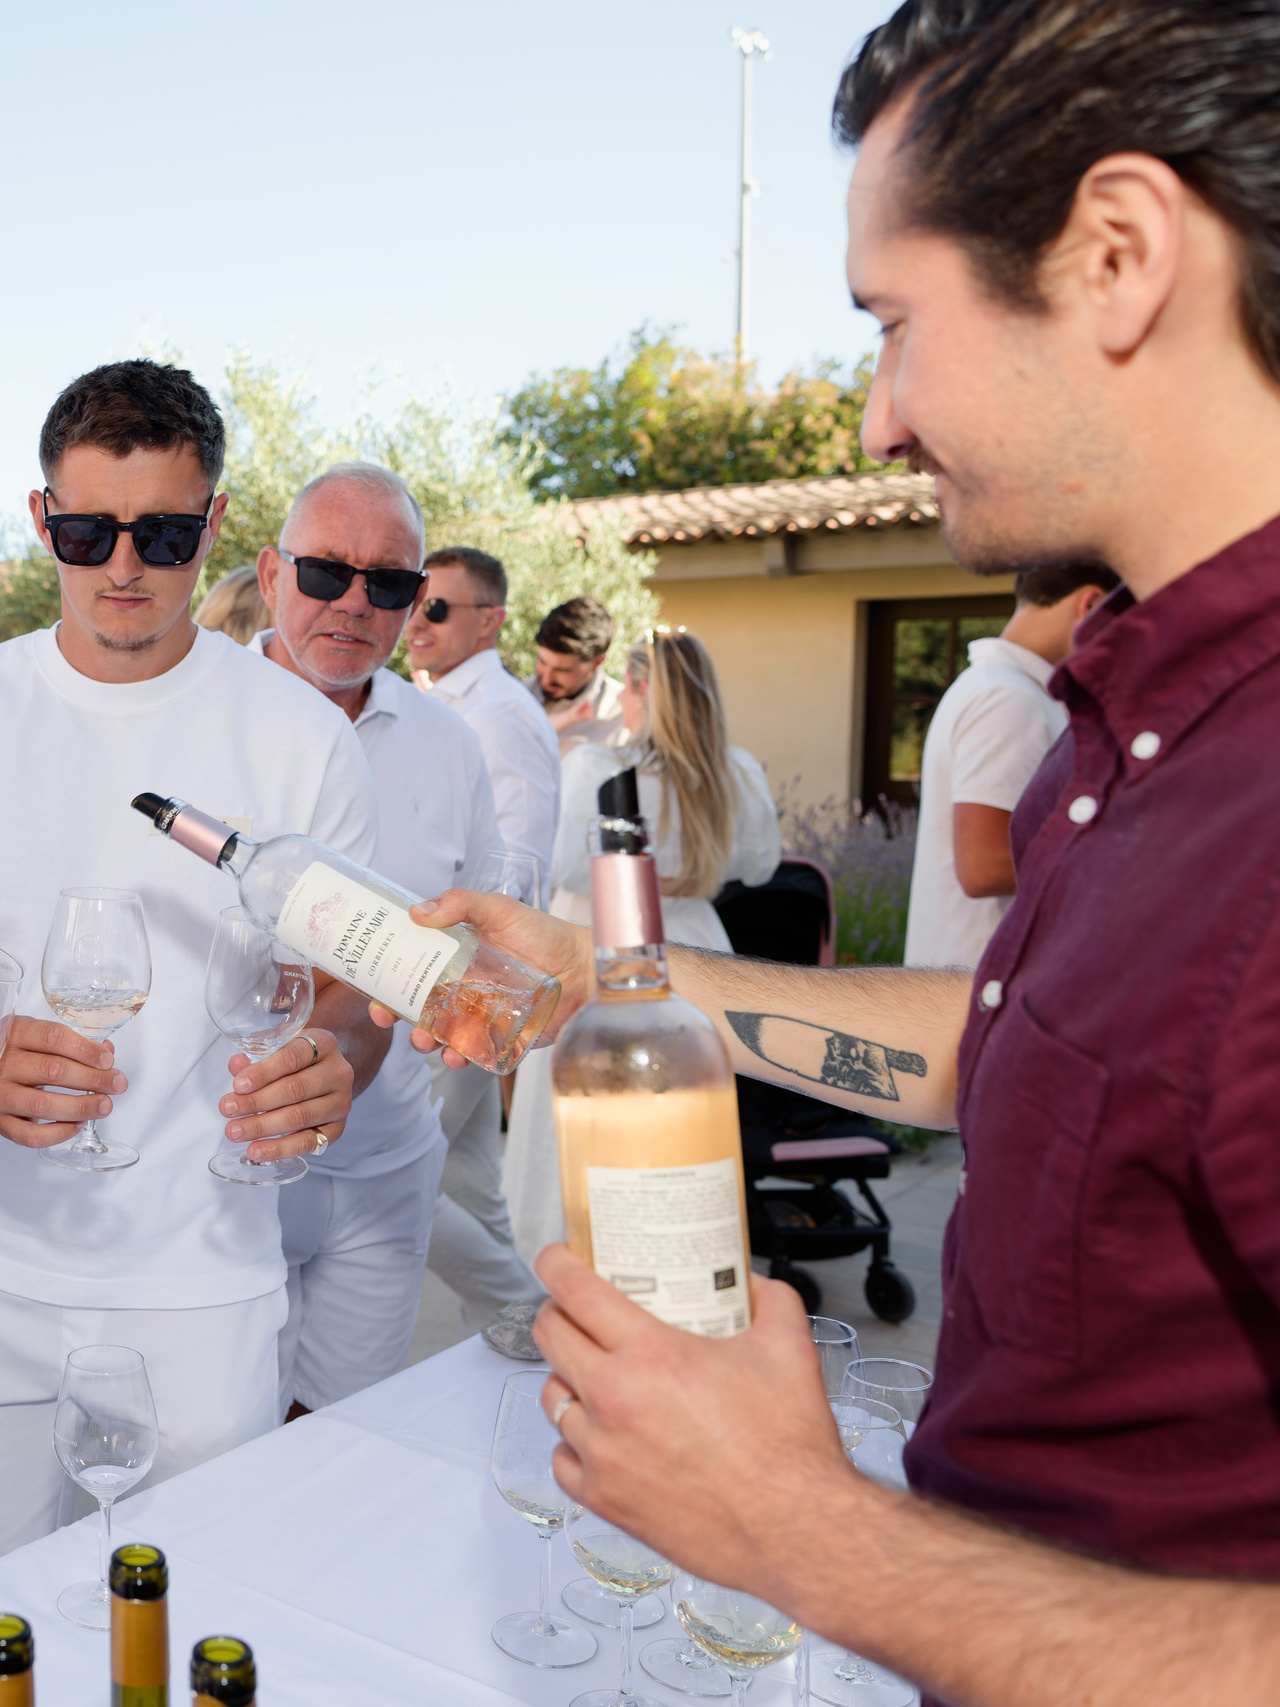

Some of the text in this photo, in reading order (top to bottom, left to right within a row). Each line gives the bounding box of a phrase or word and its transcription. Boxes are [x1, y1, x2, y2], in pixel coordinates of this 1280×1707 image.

[333, 909, 368, 960] DOMAINE
[342, 906, 390, 979] DE VILLEMAJOU
[419, 950, 442, 983] BERTRAND
